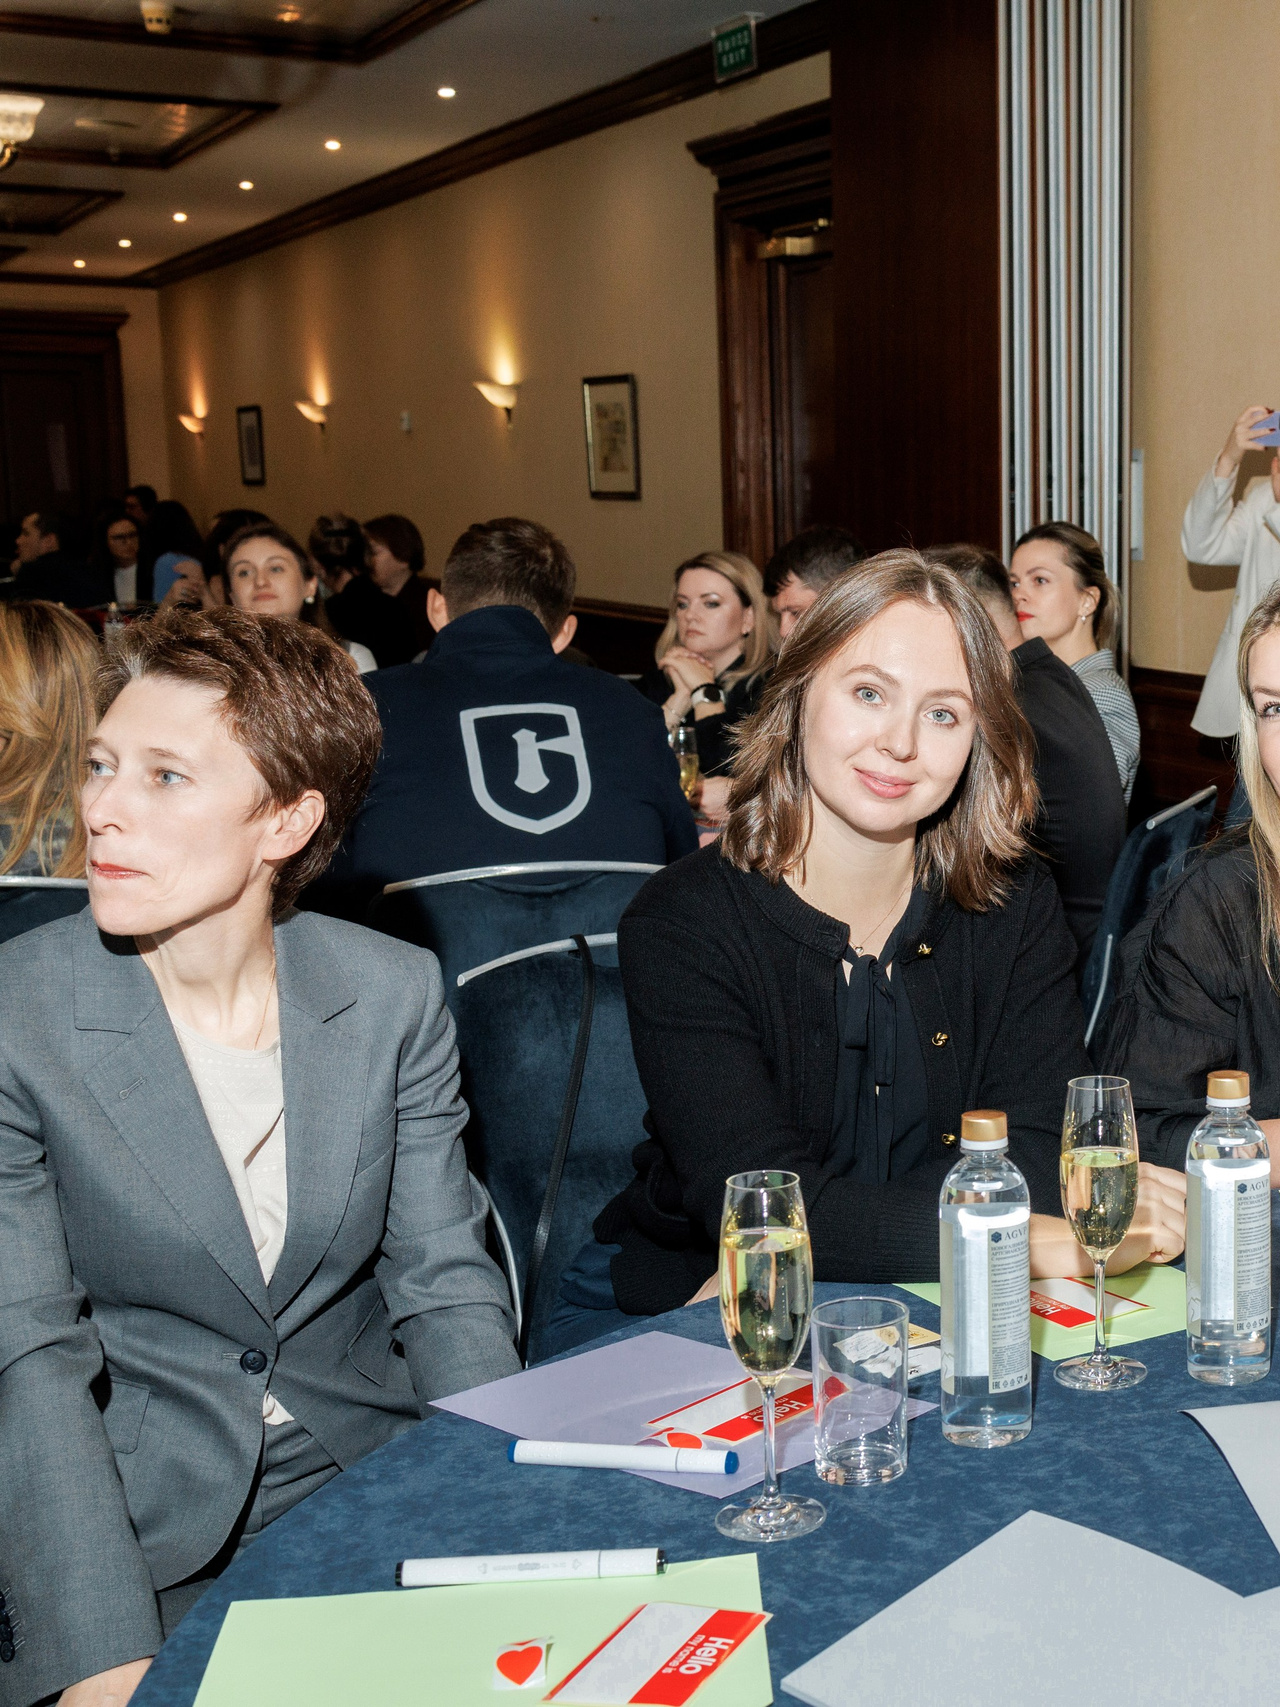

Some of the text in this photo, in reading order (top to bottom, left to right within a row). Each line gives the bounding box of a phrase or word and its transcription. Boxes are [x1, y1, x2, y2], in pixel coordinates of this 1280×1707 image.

[688, 1634, 706, 1646] my
[669, 1646, 694, 1668] name
[678, 1636, 735, 1675] Hello
